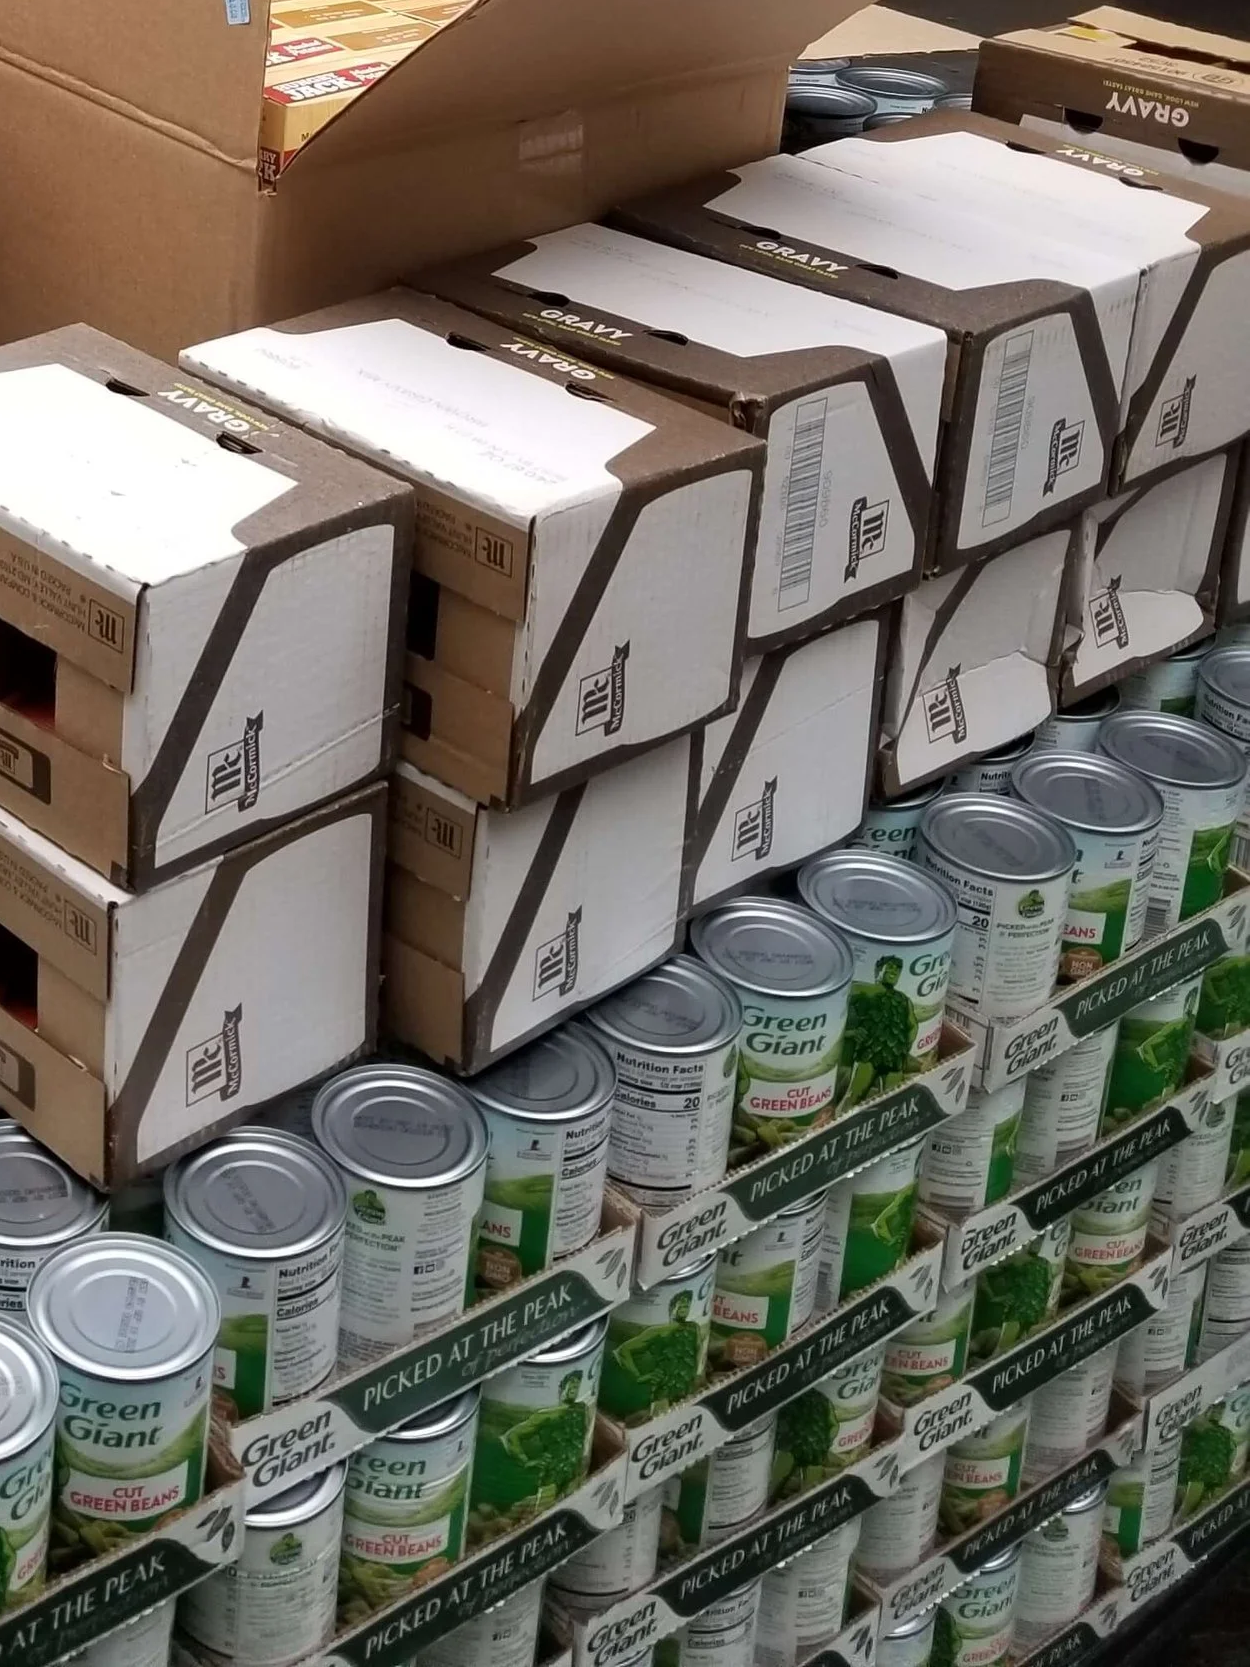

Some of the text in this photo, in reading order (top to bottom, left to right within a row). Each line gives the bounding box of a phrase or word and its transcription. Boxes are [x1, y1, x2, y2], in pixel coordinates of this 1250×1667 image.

[1106, 92, 1190, 127] GRAVY
[1055, 147, 1147, 178] GRAVY
[755, 241, 849, 272] GRAVY
[540, 309, 635, 339] GRAVY
[500, 342, 597, 381] GRAVY
[158, 389, 247, 432] GRAVY
[849, 500, 862, 573] McCormick
[1108, 589, 1129, 647] McCormick
[612, 656, 624, 731] McCormick
[946, 675, 967, 739] McCormick
[244, 719, 259, 808] McCormick
[761, 788, 773, 856] McCormick
[963, 878, 994, 896] Facts
[972, 914, 989, 928] 20
[566, 920, 579, 992] McCormick
[1075, 929, 1210, 1018] PICKED AT THE PEAK
[742, 1004, 827, 1033] Green
[1004, 1016, 1058, 1060] Green
[225, 1017, 240, 1097] McCormick
[616, 1051, 704, 1075] Nutrition Facts
[746, 1033, 827, 1057] Giant
[1007, 1037, 1054, 1076] Giant
[683, 1096, 700, 1110] 20
[750, 1087, 832, 1112] GREEN BEANS
[786, 1086, 811, 1100] CUT
[750, 1094, 920, 1203] PICKED AT THE PEAK
[1035, 1117, 1173, 1216] PICKED THE PEAK
[657, 1200, 728, 1251] Green
[662, 1219, 724, 1268] Giant
[278, 1252, 329, 1280] Nutrition
[1074, 1244, 1117, 1261] GREEN
[276, 1297, 319, 1318] Calories
[714, 1306, 759, 1325] BEANS
[363, 1282, 573, 1412] PICKED AT THE PEAK
[726, 1299, 891, 1415] PICKED AT THE PEAK
[911, 1356, 949, 1371] BEANS
[992, 1295, 1133, 1394] PICKED THE PEAK
[60, 1380, 162, 1421] Green
[913, 1392, 972, 1437] Green
[63, 1415, 163, 1450] Giant
[242, 1410, 332, 1468] Green
[631, 1413, 703, 1463] Green
[919, 1413, 971, 1451] Giant
[253, 1432, 330, 1488] Giant
[639, 1436, 700, 1481] Giant
[70, 1485, 180, 1514] GREEN BEANS
[113, 1485, 146, 1499] CUT
[382, 1534, 409, 1547] CUT
[399, 1535, 443, 1556] BEANS
[679, 1486, 852, 1600] PICKED THE PEAK
[10, 1550, 166, 1650] AT THE PEAK
[365, 1521, 569, 1660] PICKED AT THE PEAK
[587, 1600, 657, 1653] Green
